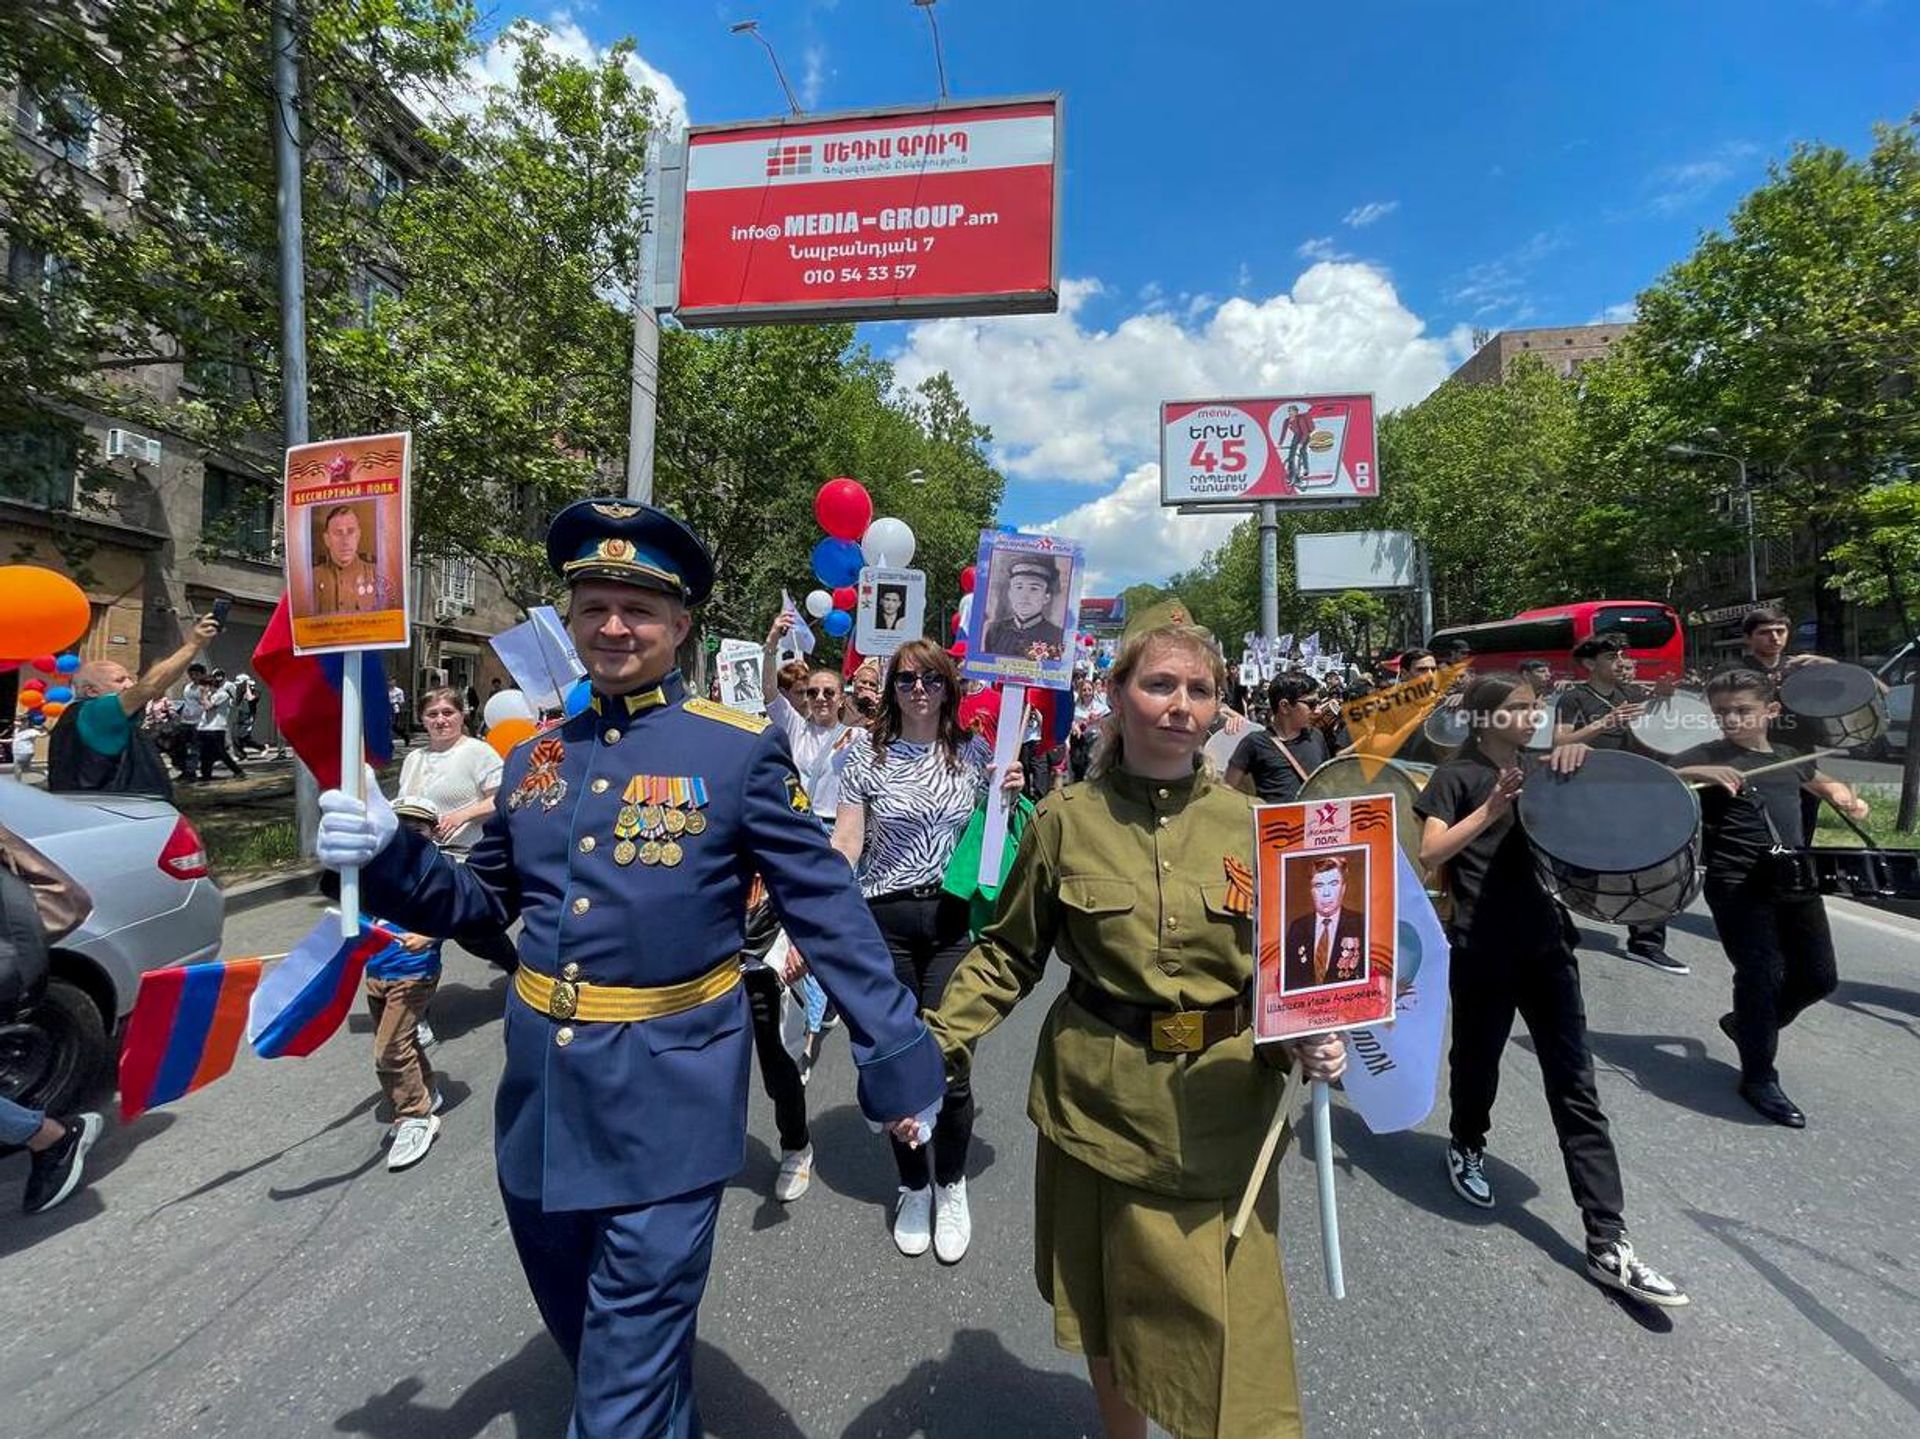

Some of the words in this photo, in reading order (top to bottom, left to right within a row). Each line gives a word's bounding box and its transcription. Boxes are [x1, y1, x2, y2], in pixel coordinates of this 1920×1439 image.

[823, 138, 892, 163] ՄԵԴԻԱ
[897, 132, 968, 157] ԳՐՈՒՊ
[789, 238, 917, 262] Նալբանդյան
[923, 237, 935, 251] 7
[804, 269, 835, 284] 010
[840, 267, 862, 282] 54
[867, 266, 889, 280] 33
[894, 264, 917, 279] 57
[1190, 440, 1247, 473] 45
[294, 484, 362, 503] БЕССМЕРТНЫЙ
[366, 482, 395, 495] ПОЛК
[1314, 836, 1339, 846] ПОЛК
[1351, 1030, 1397, 1076] ПОЛК
